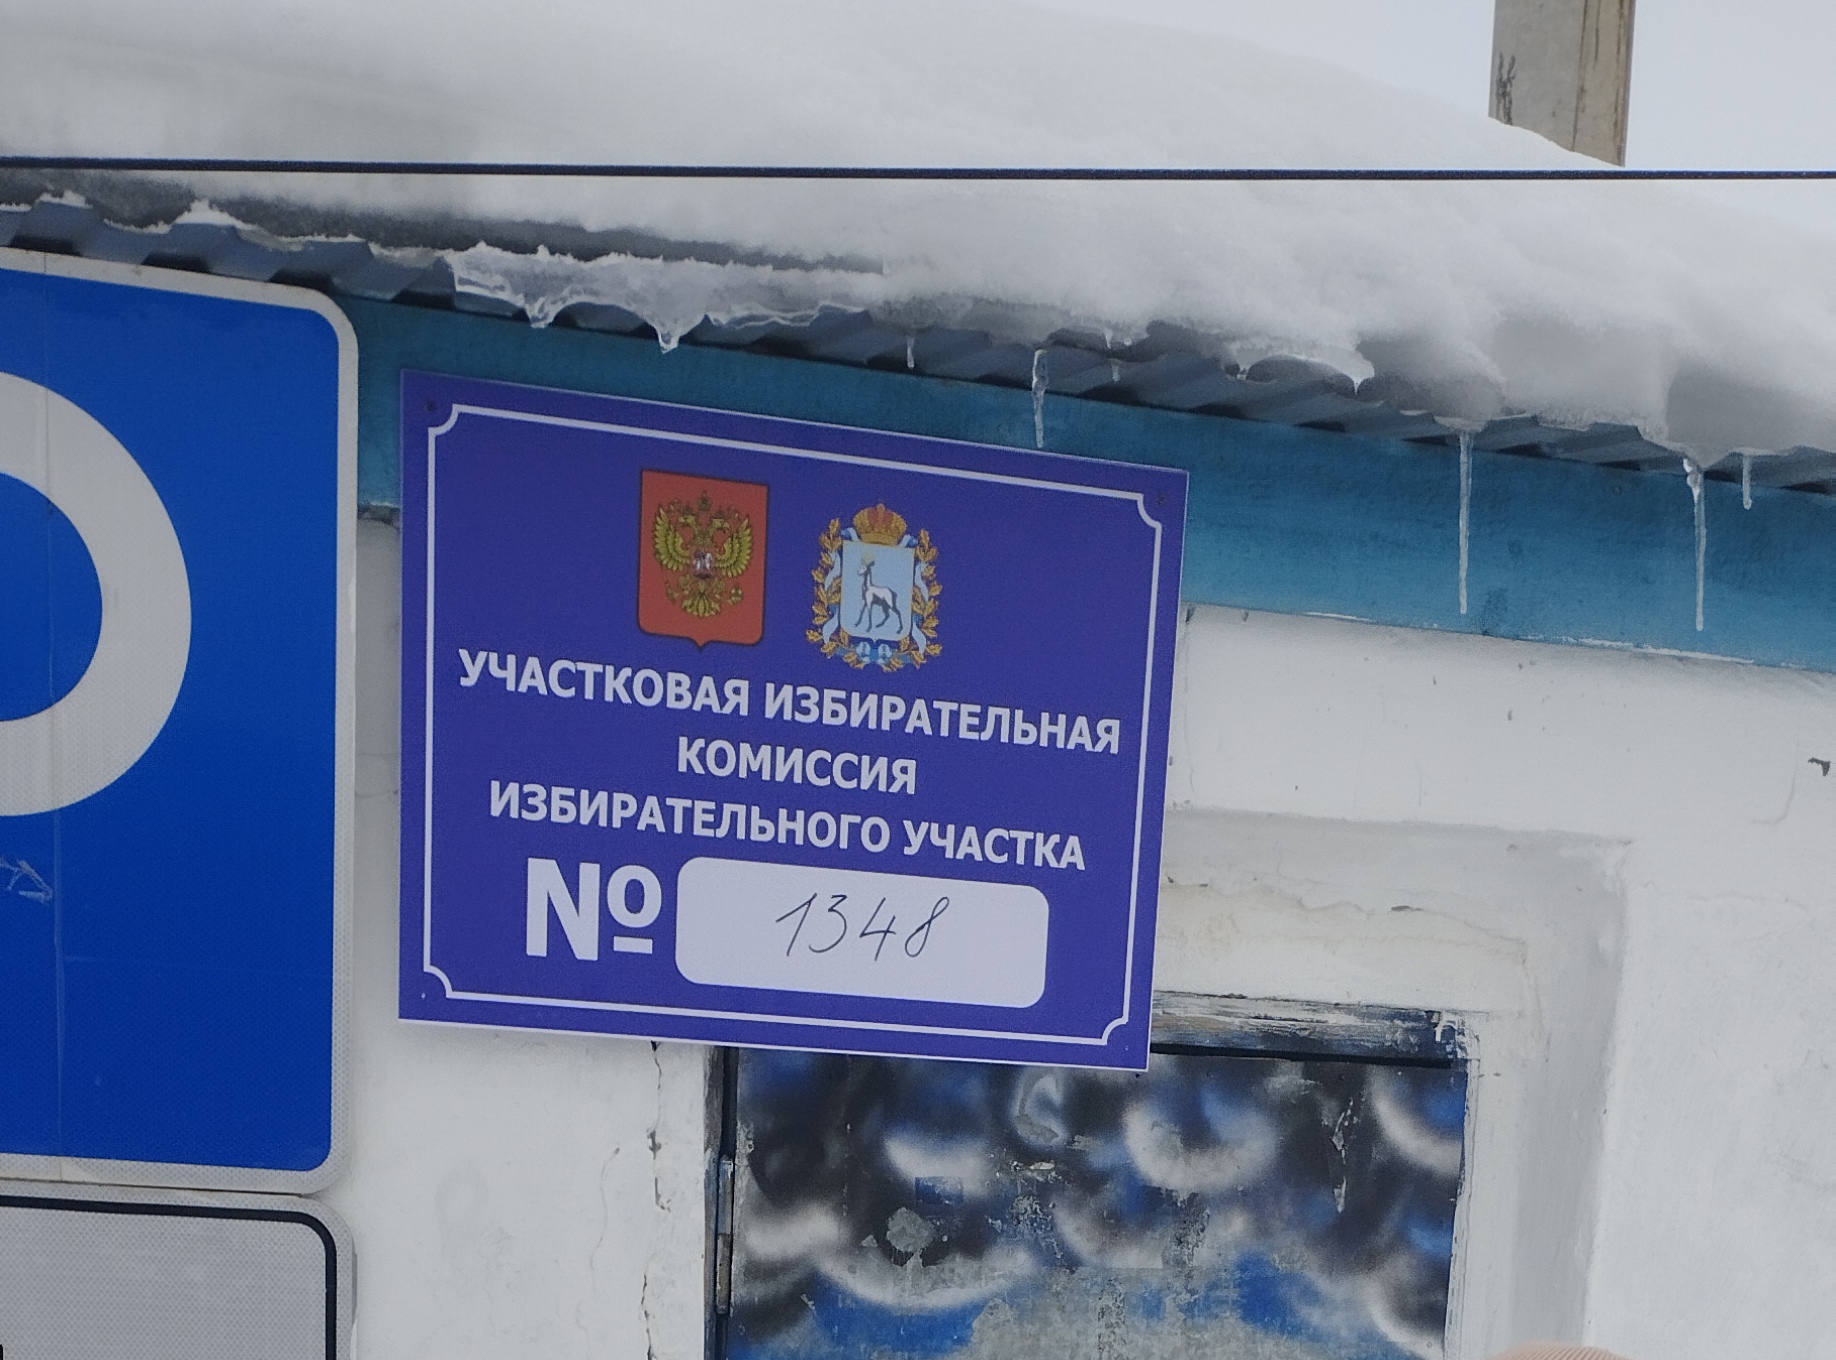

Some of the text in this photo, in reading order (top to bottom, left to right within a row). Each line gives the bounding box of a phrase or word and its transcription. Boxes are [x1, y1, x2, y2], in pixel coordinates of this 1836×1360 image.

[457, 647, 1122, 756] УЧАСТКОВАЯ ИЗБИРАТЕЛЬНАЯ
[677, 735, 918, 796] КОМИССИЯ
[489, 779, 1087, 872] ИЗБИРАТЕЛЬНОГО УЧАСТКА
[774, 892, 951, 962] 1348
